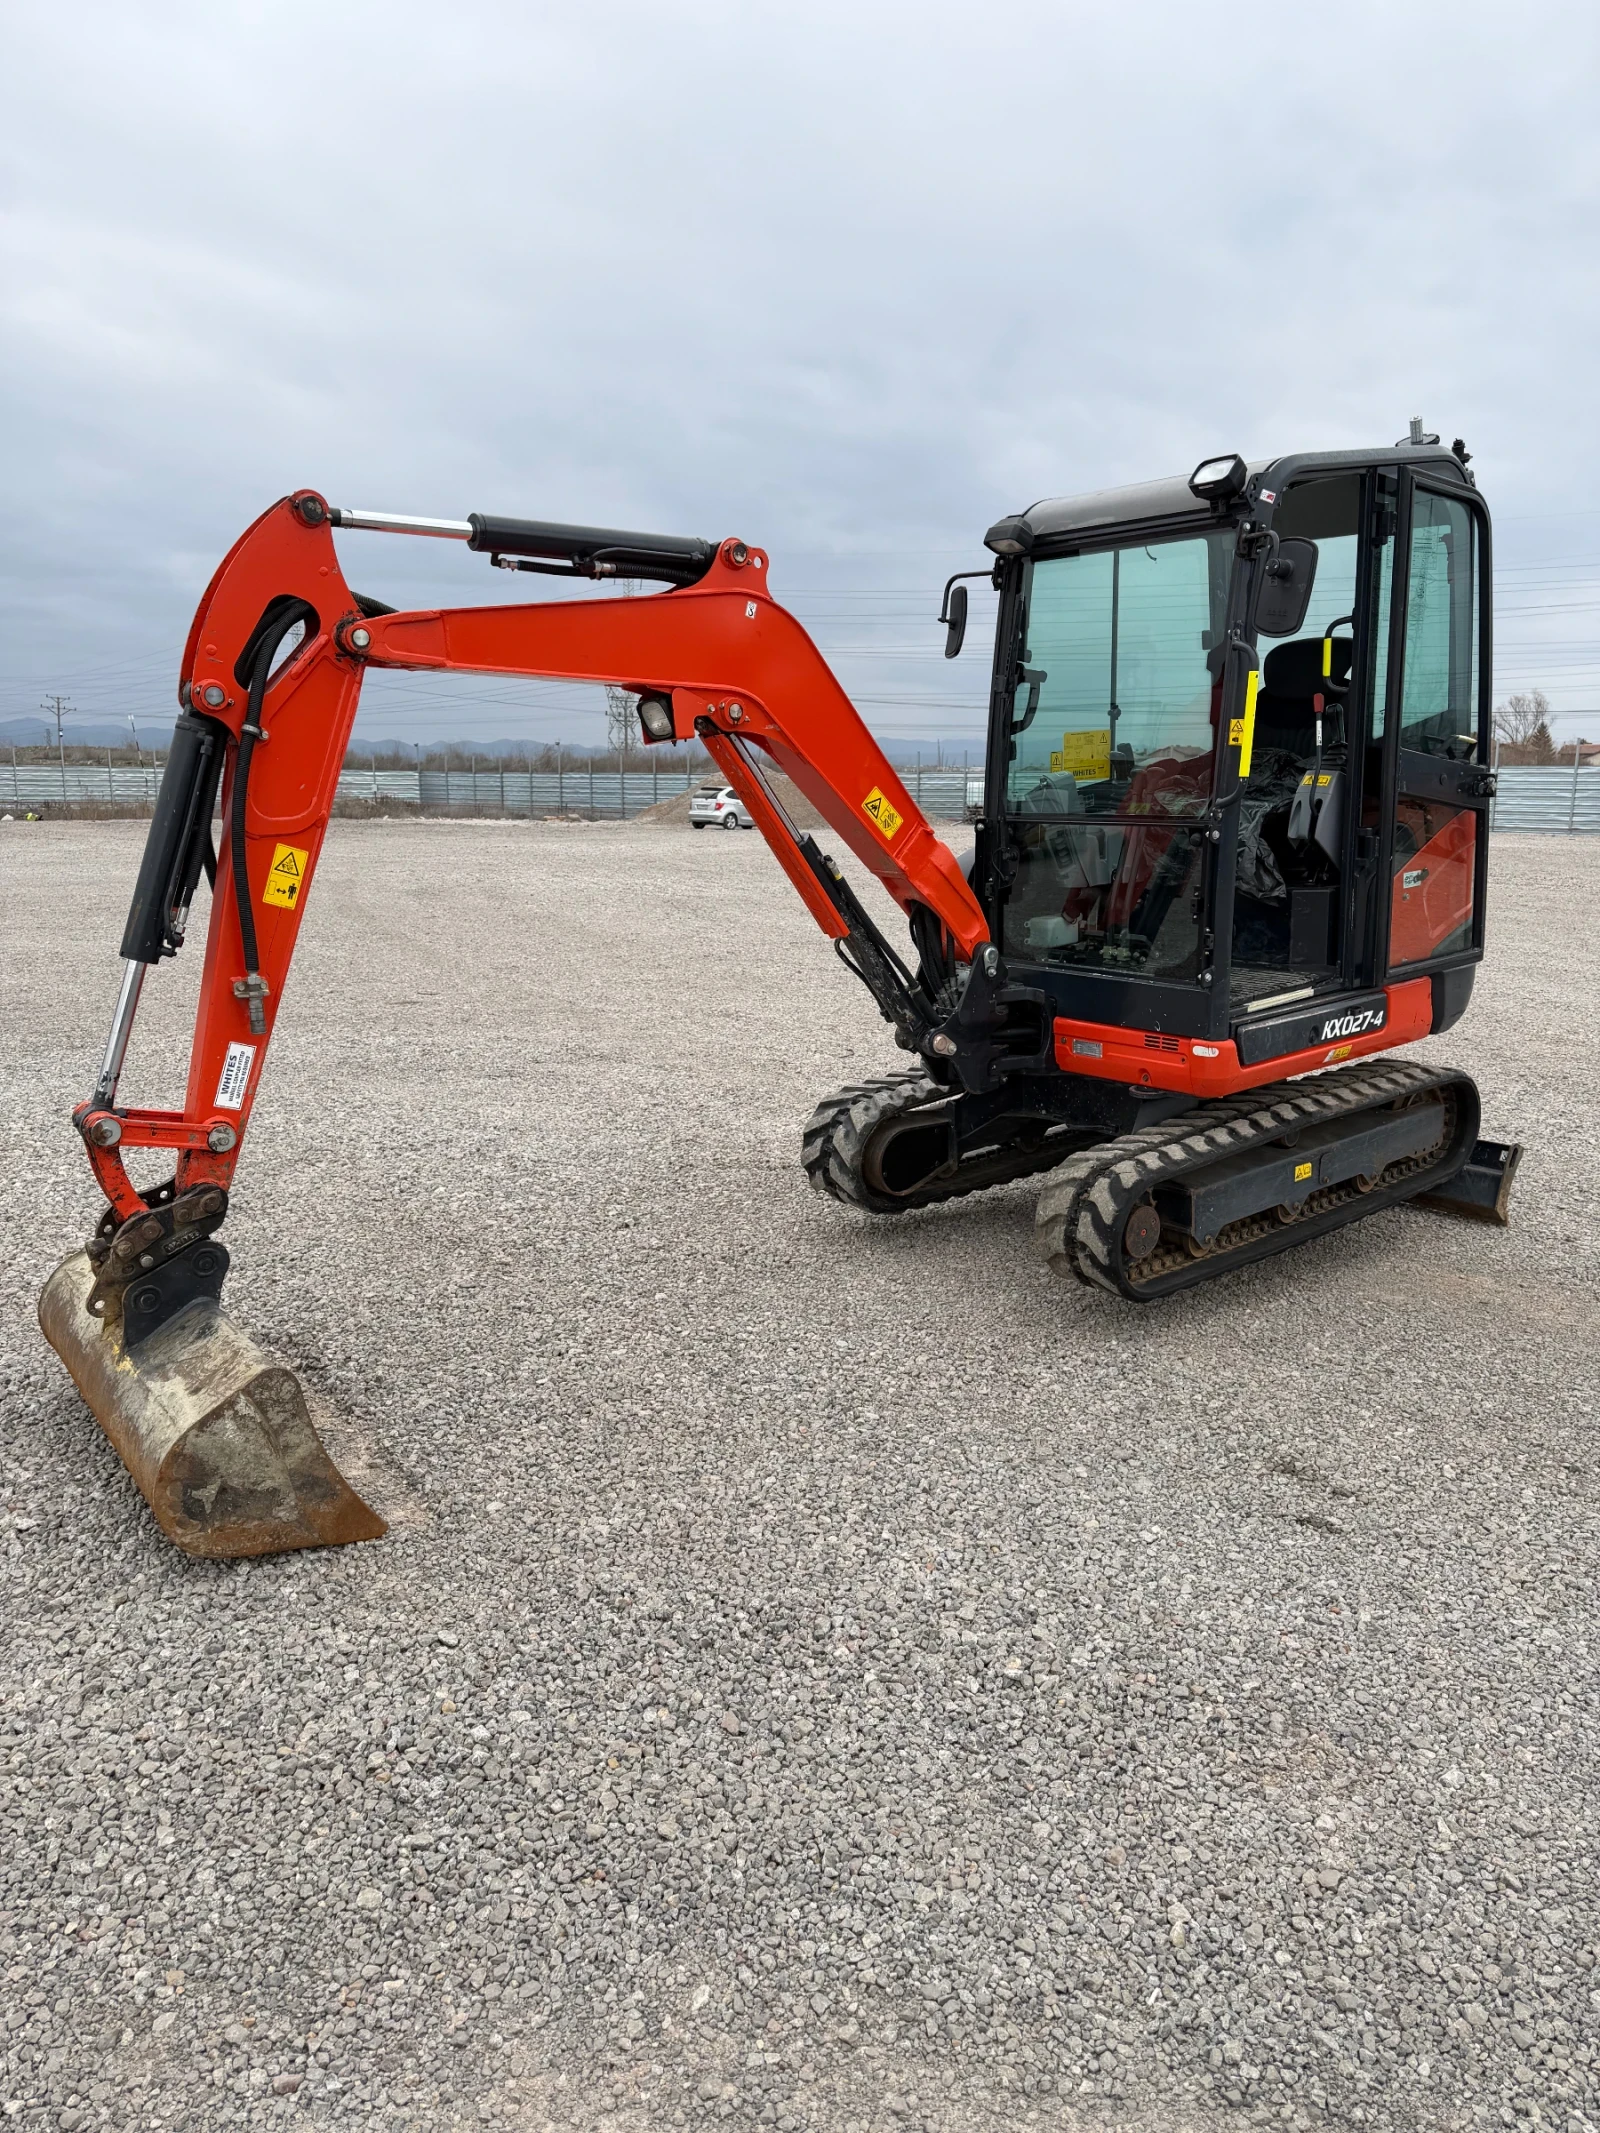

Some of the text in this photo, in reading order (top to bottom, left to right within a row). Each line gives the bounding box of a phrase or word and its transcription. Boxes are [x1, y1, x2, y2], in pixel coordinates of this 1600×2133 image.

[1072, 769, 1096, 777] WHITES
[1321, 1010, 1384, 1040] KX027-4
[220, 1055, 237, 1095] WHITES
